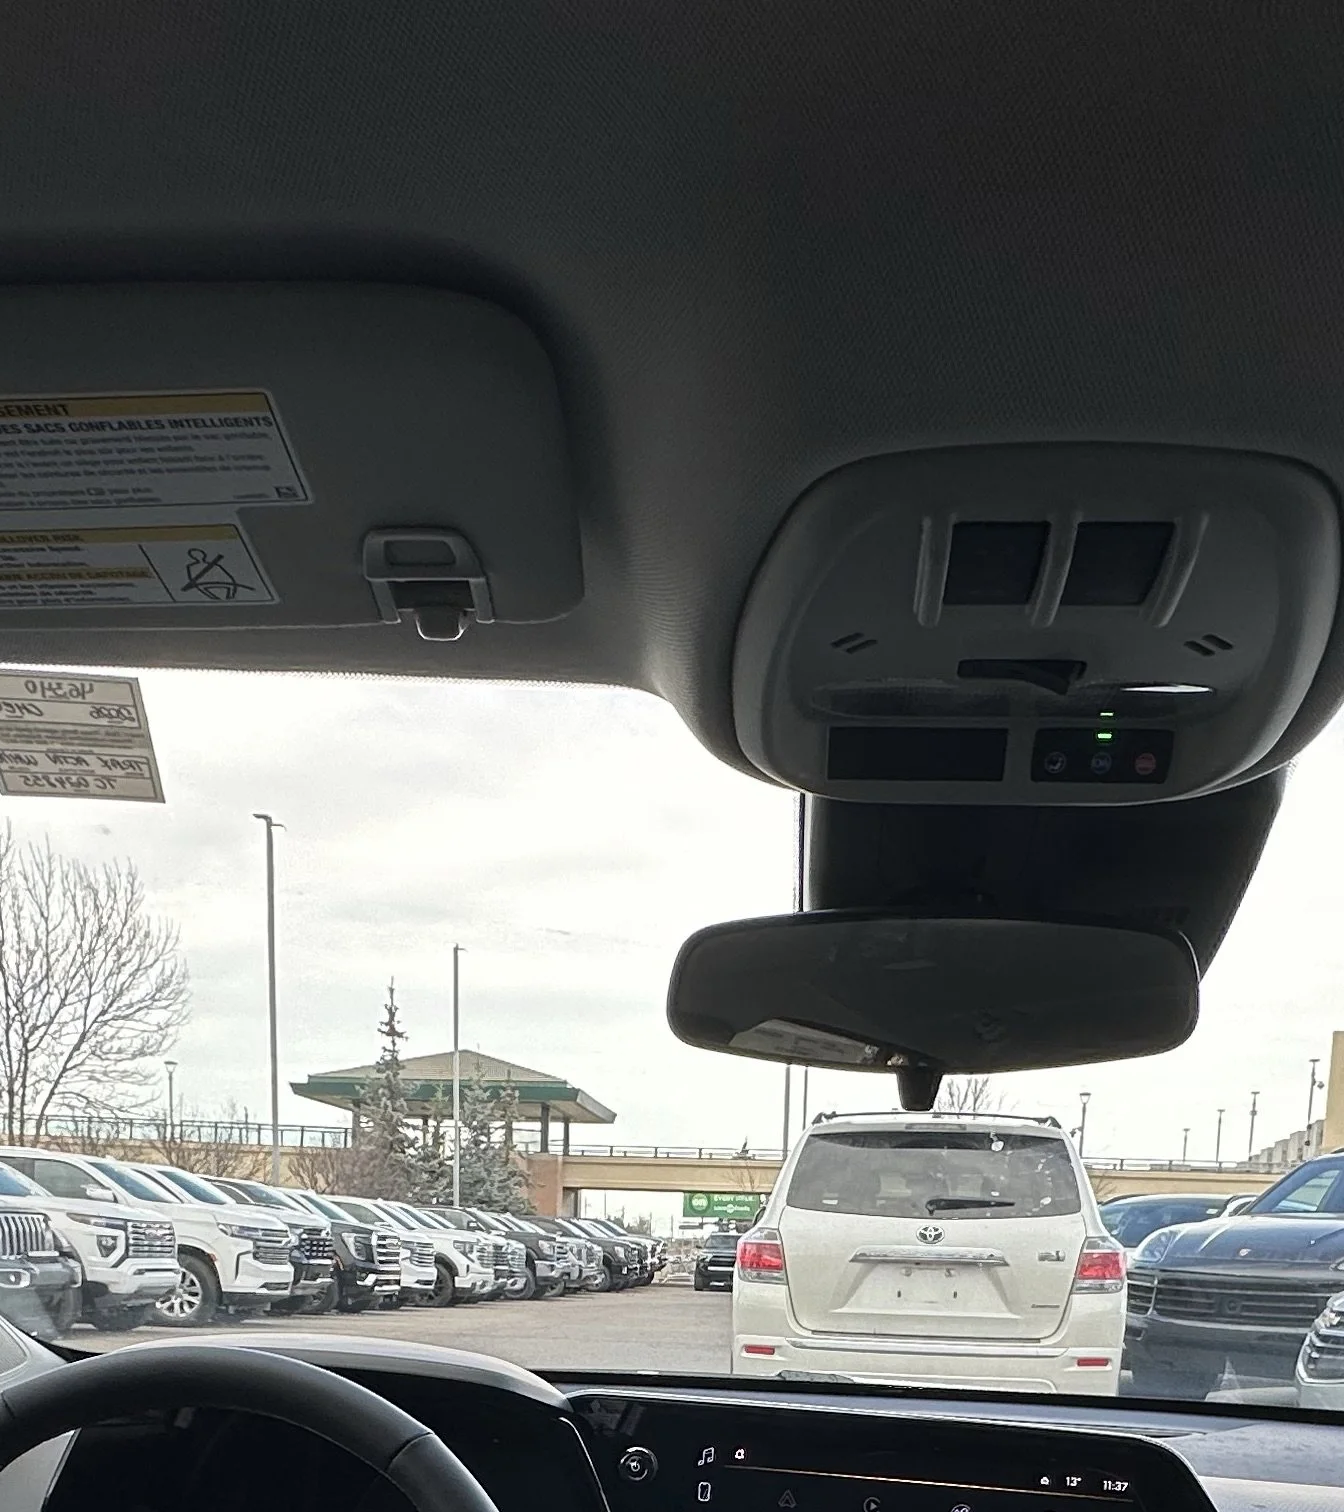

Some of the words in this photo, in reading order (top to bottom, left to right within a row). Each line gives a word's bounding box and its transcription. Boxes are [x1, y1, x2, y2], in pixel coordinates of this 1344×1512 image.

[23, 422, 67, 434] SACS
[68, 419, 166, 433] GONFLABLES
[166, 416, 273, 430] INTELLIGENTS
[1065, 1476, 1082, 1487] 13°
[1102, 1480, 1129, 1492] 11:37
